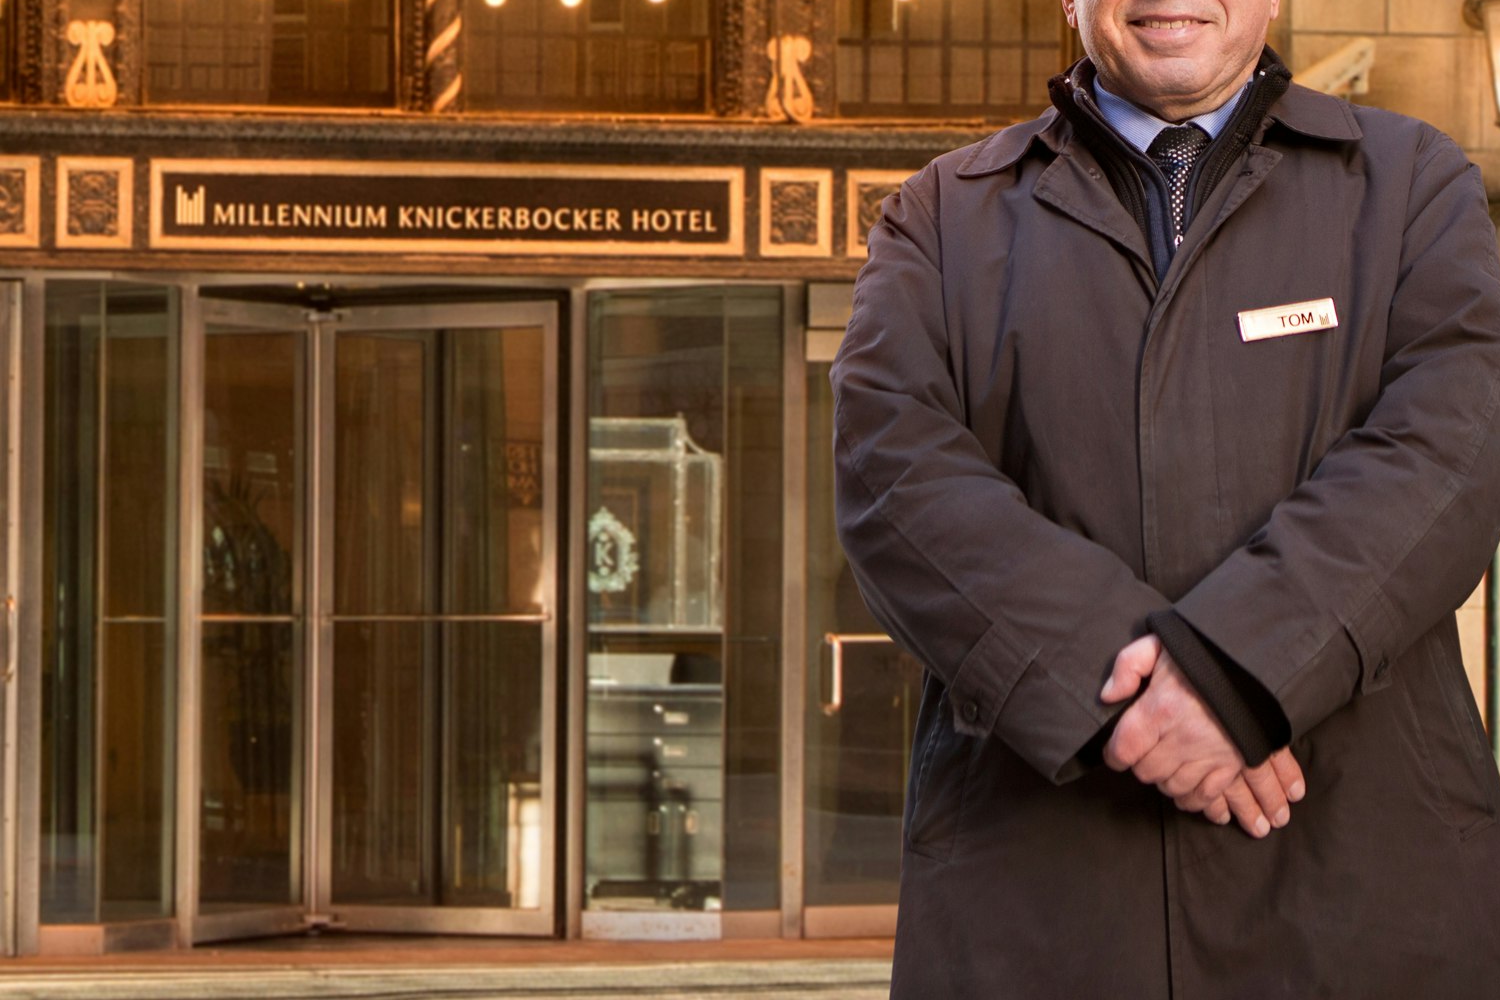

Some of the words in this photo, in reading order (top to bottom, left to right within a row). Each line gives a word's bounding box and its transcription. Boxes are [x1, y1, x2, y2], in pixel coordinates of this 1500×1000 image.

[213, 203, 387, 227] MILLENNIUM
[398, 206, 622, 230] KNICKERBOCKER
[632, 209, 717, 232] HOTEL
[1277, 312, 1314, 328] TOM
[595, 541, 614, 566] K
